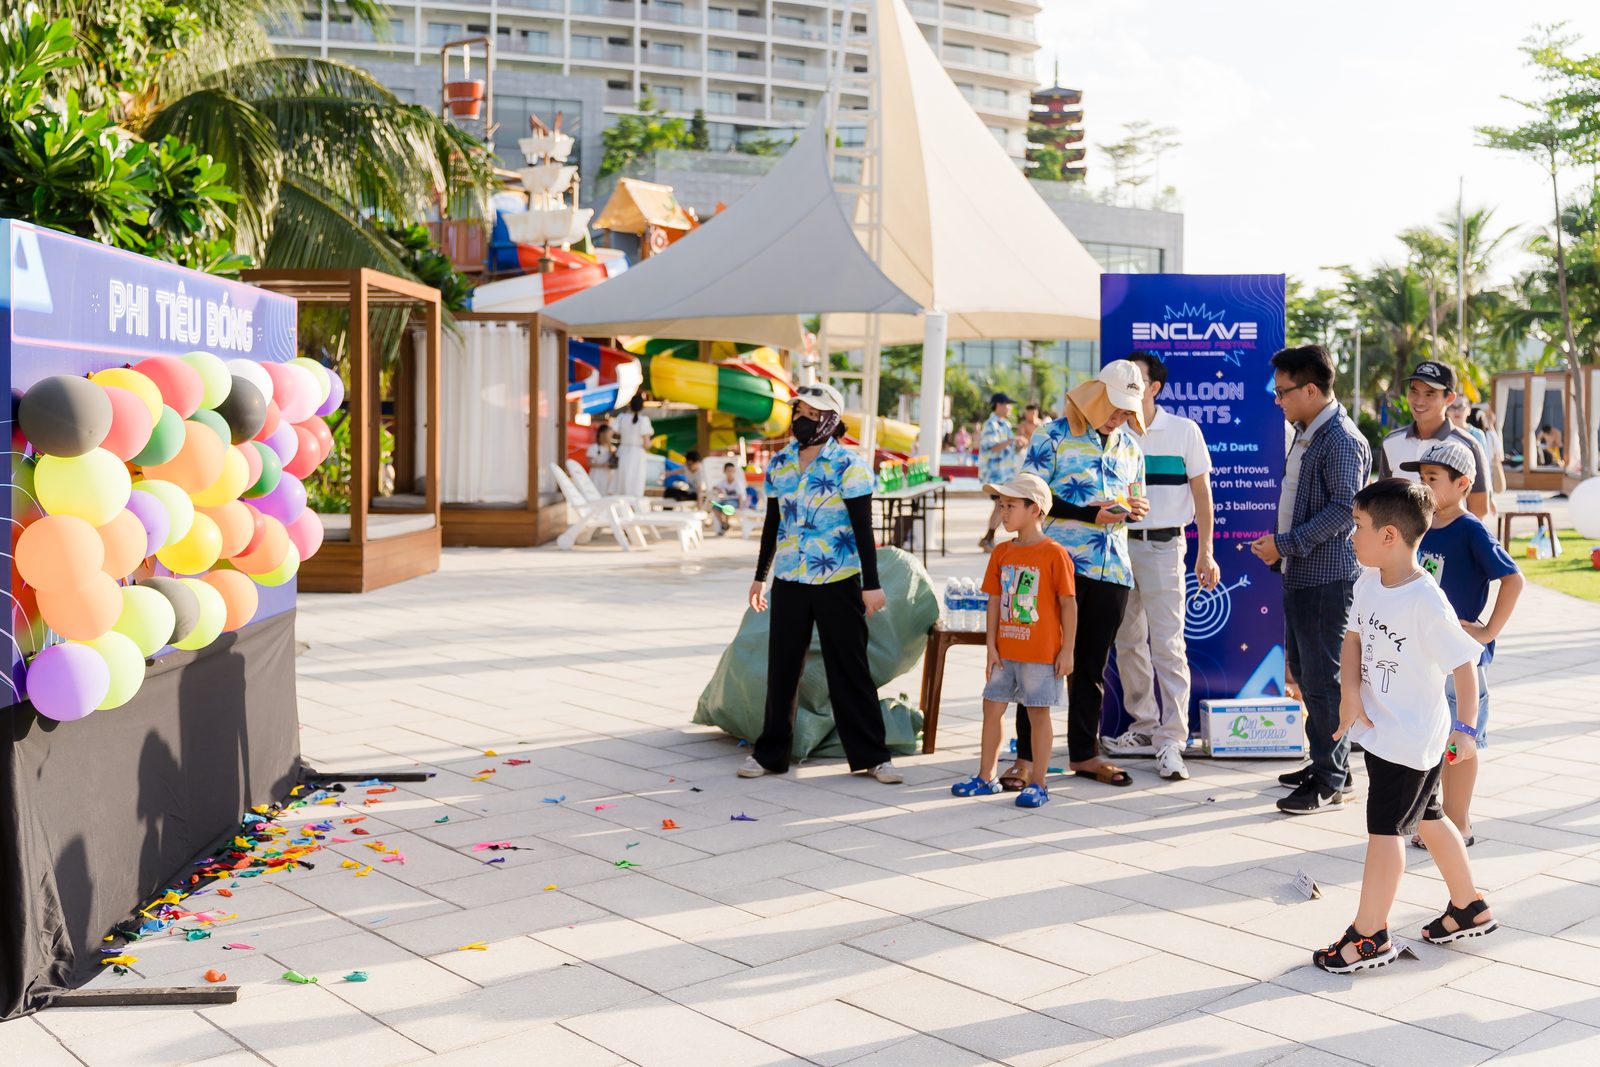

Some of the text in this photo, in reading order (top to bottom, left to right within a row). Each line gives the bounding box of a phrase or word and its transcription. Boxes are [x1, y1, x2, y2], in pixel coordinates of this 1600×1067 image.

[109, 280, 253, 352] PHI TIÊU BÓNG
[1132, 322, 1257, 340] ENCLAVE
[1155, 381, 1244, 401] ALLOON
[1206, 442, 1258, 453] ns/3 Darts
[1211, 465, 1269, 476] ayer throws
[1220, 480, 1233, 489] on
[1235, 479, 1252, 488] the
[1254, 479, 1277, 488] wall.
[1225, 501, 1231, 510] 3
[1233, 501, 1277, 511] balloons
[1223, 531, 1230, 539] a
[1232, 529, 1270, 539] reward
[1368, 612, 1407, 652] beach
